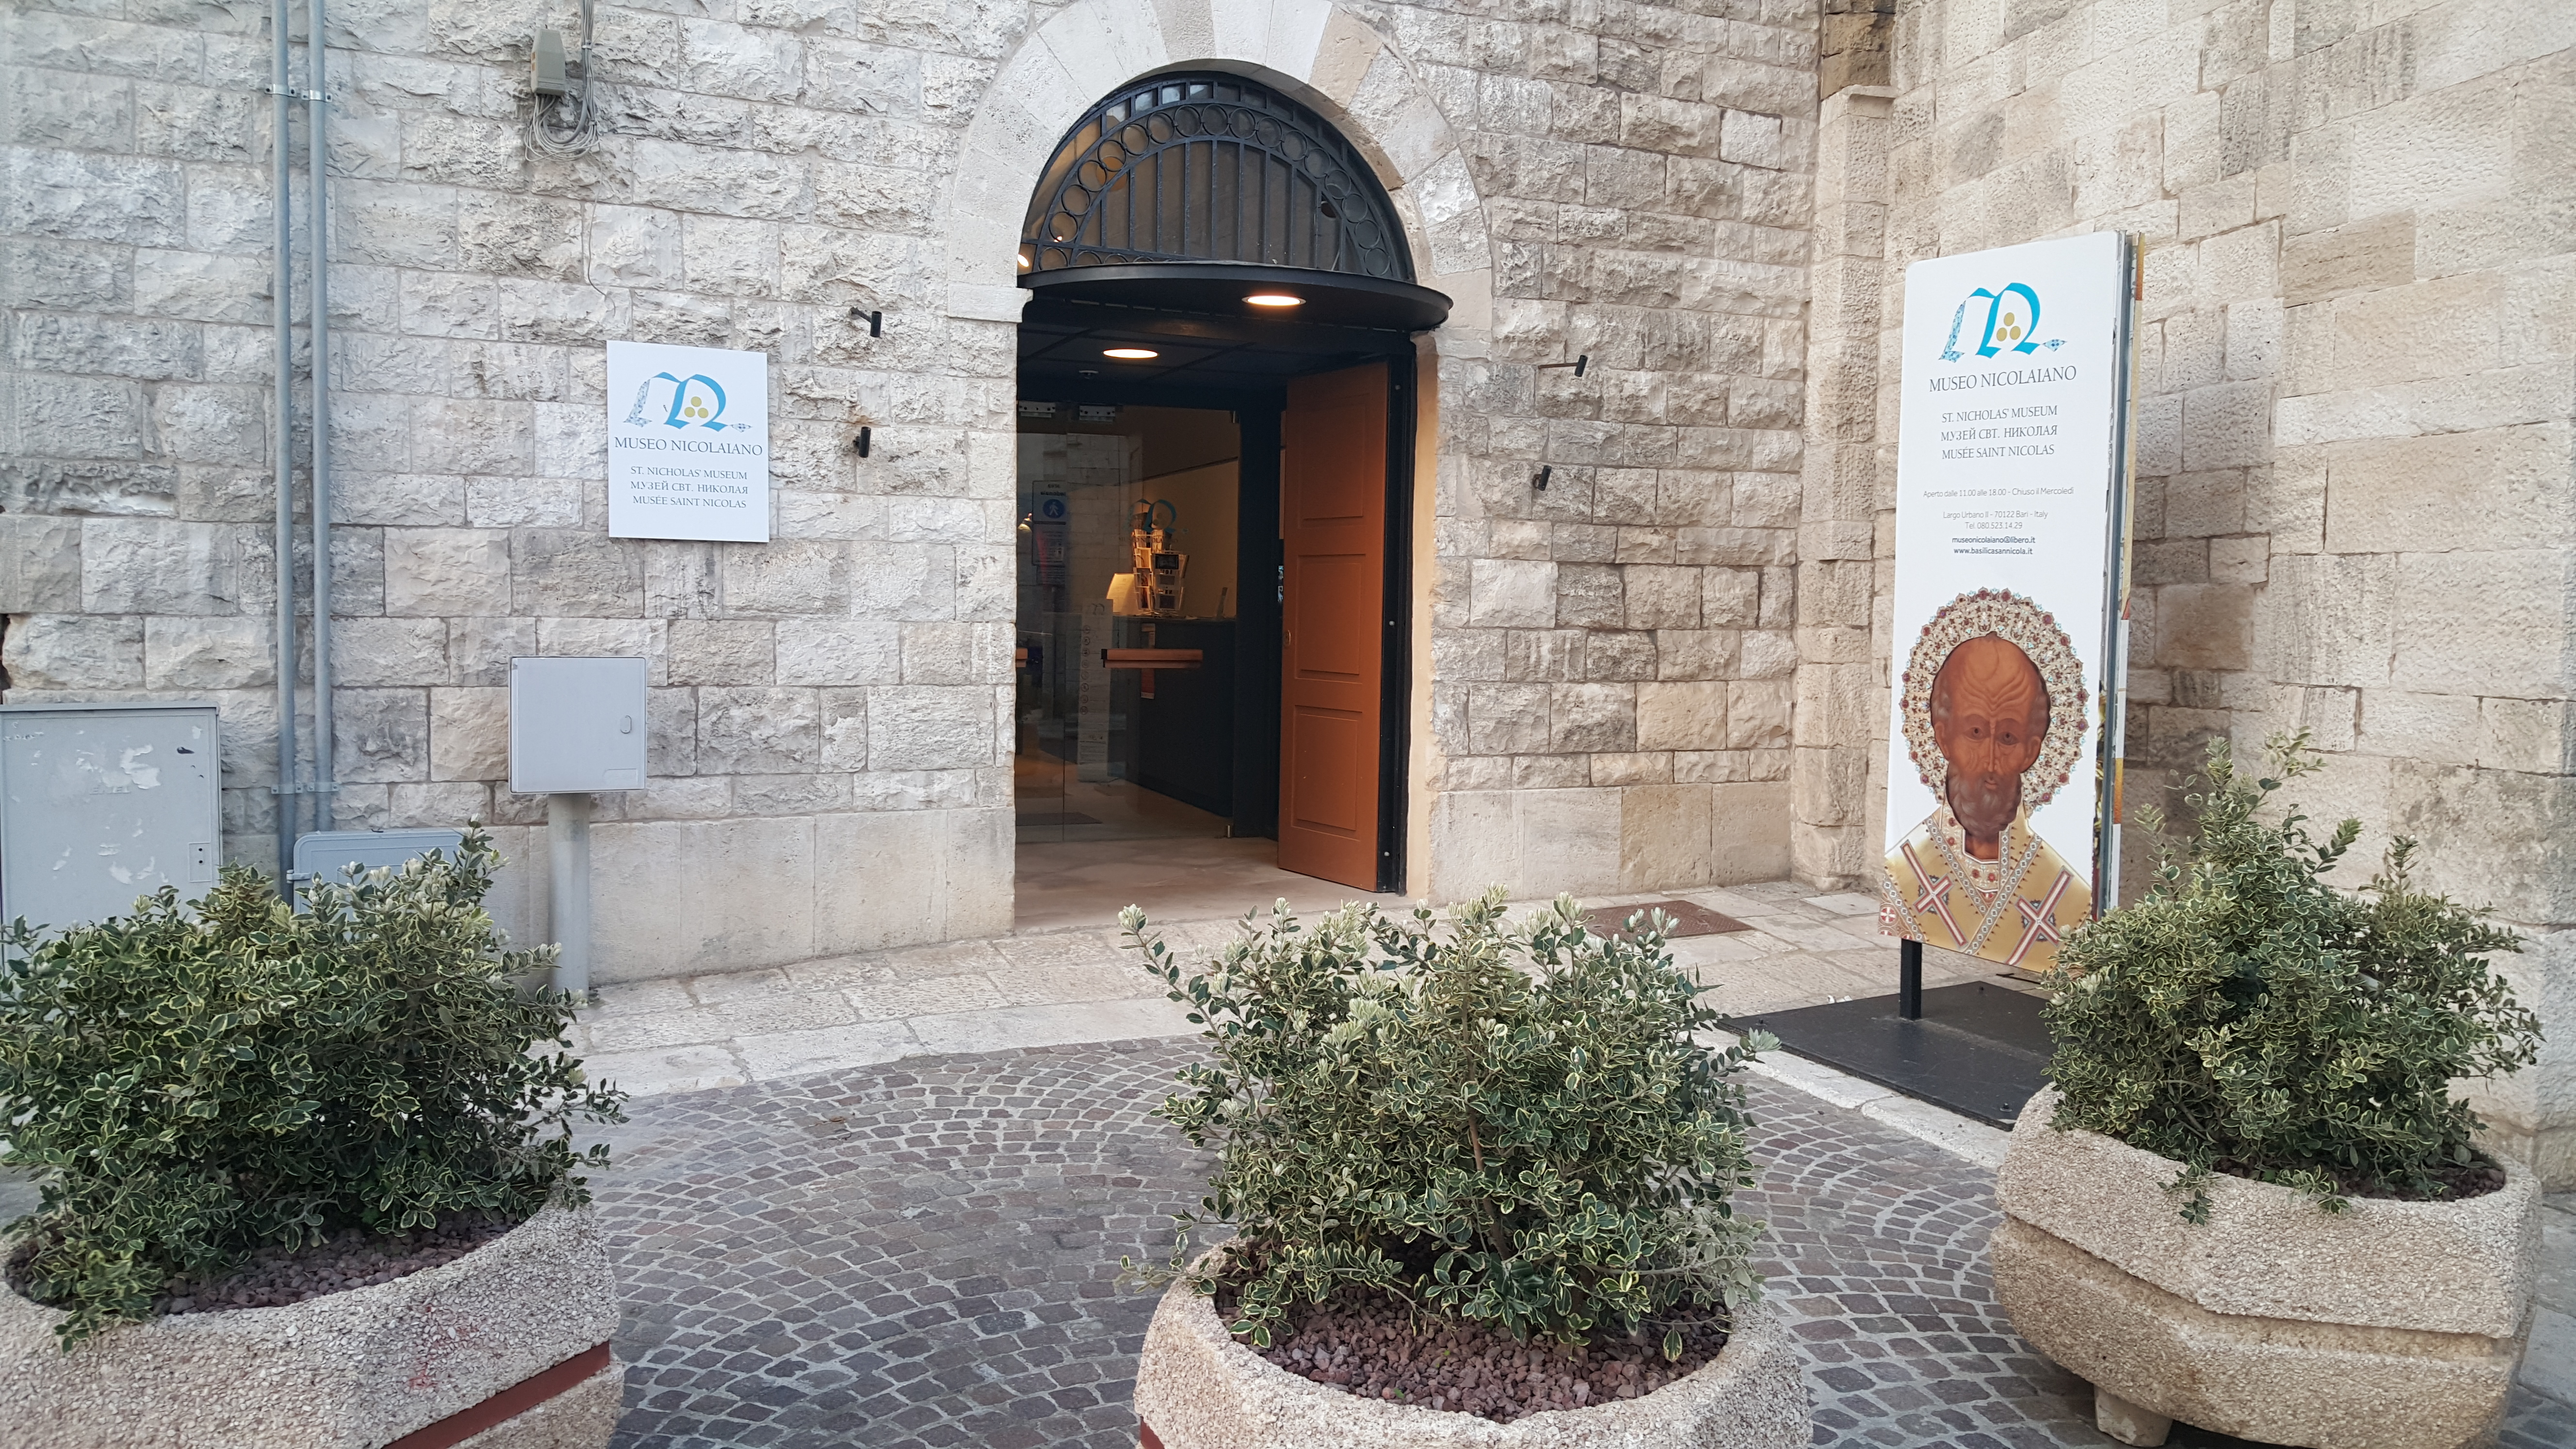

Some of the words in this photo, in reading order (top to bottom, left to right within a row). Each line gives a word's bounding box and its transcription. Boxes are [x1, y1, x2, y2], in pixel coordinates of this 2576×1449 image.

[1930, 375, 1977, 391] MUSEO
[1981, 366, 2076, 387] NICOLAIANO
[1942, 413, 1954, 422] ST.
[2012, 406, 2058, 418] MUSEUM
[1941, 428, 1976, 441] МУЗЕЙ
[1979, 429, 1999, 439] СВТ.
[2004, 426, 2058, 437] НИКОЛАЯ
[615, 437, 666, 451] MUSEO
[672, 440, 762, 455] NICOLAIANO
[1942, 447, 1974, 459] MUSÉE
[1977, 447, 2006, 457] SAINT
[2008, 445, 2054, 456] NICOLAS
[704, 470, 747, 479] MUSEUM
[631, 481, 668, 490] МУЗЕЙ
[698, 485, 747, 494] НИКОЛАЯ
[633, 495, 667, 505] MUSÉE
[671, 498, 700, 506] SAINT
[703, 499, 746, 508] NICOLAS
[2034, 510, 2048, 519] Italy
